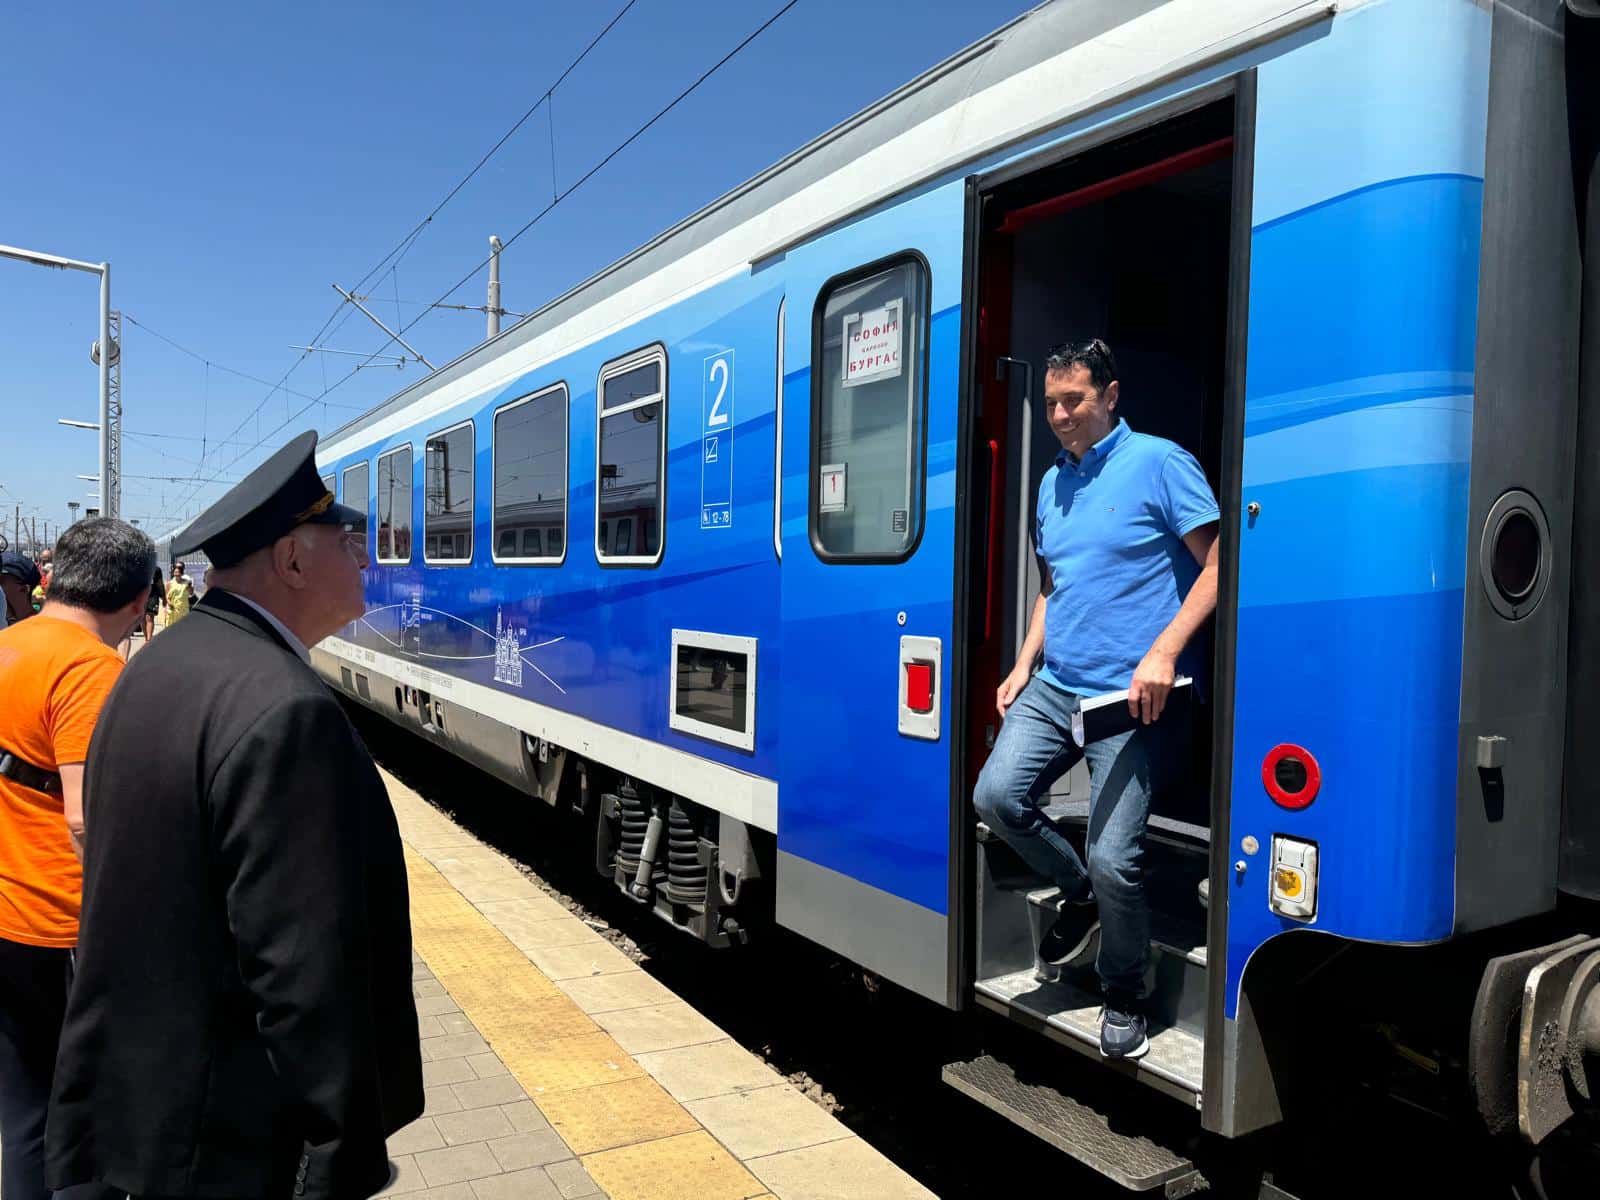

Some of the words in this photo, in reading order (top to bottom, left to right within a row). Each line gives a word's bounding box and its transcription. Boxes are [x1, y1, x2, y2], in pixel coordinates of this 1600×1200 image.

[853, 320, 898, 342] СОФИЯ
[708, 358, 729, 426] 2
[831, 473, 836, 493] 1
